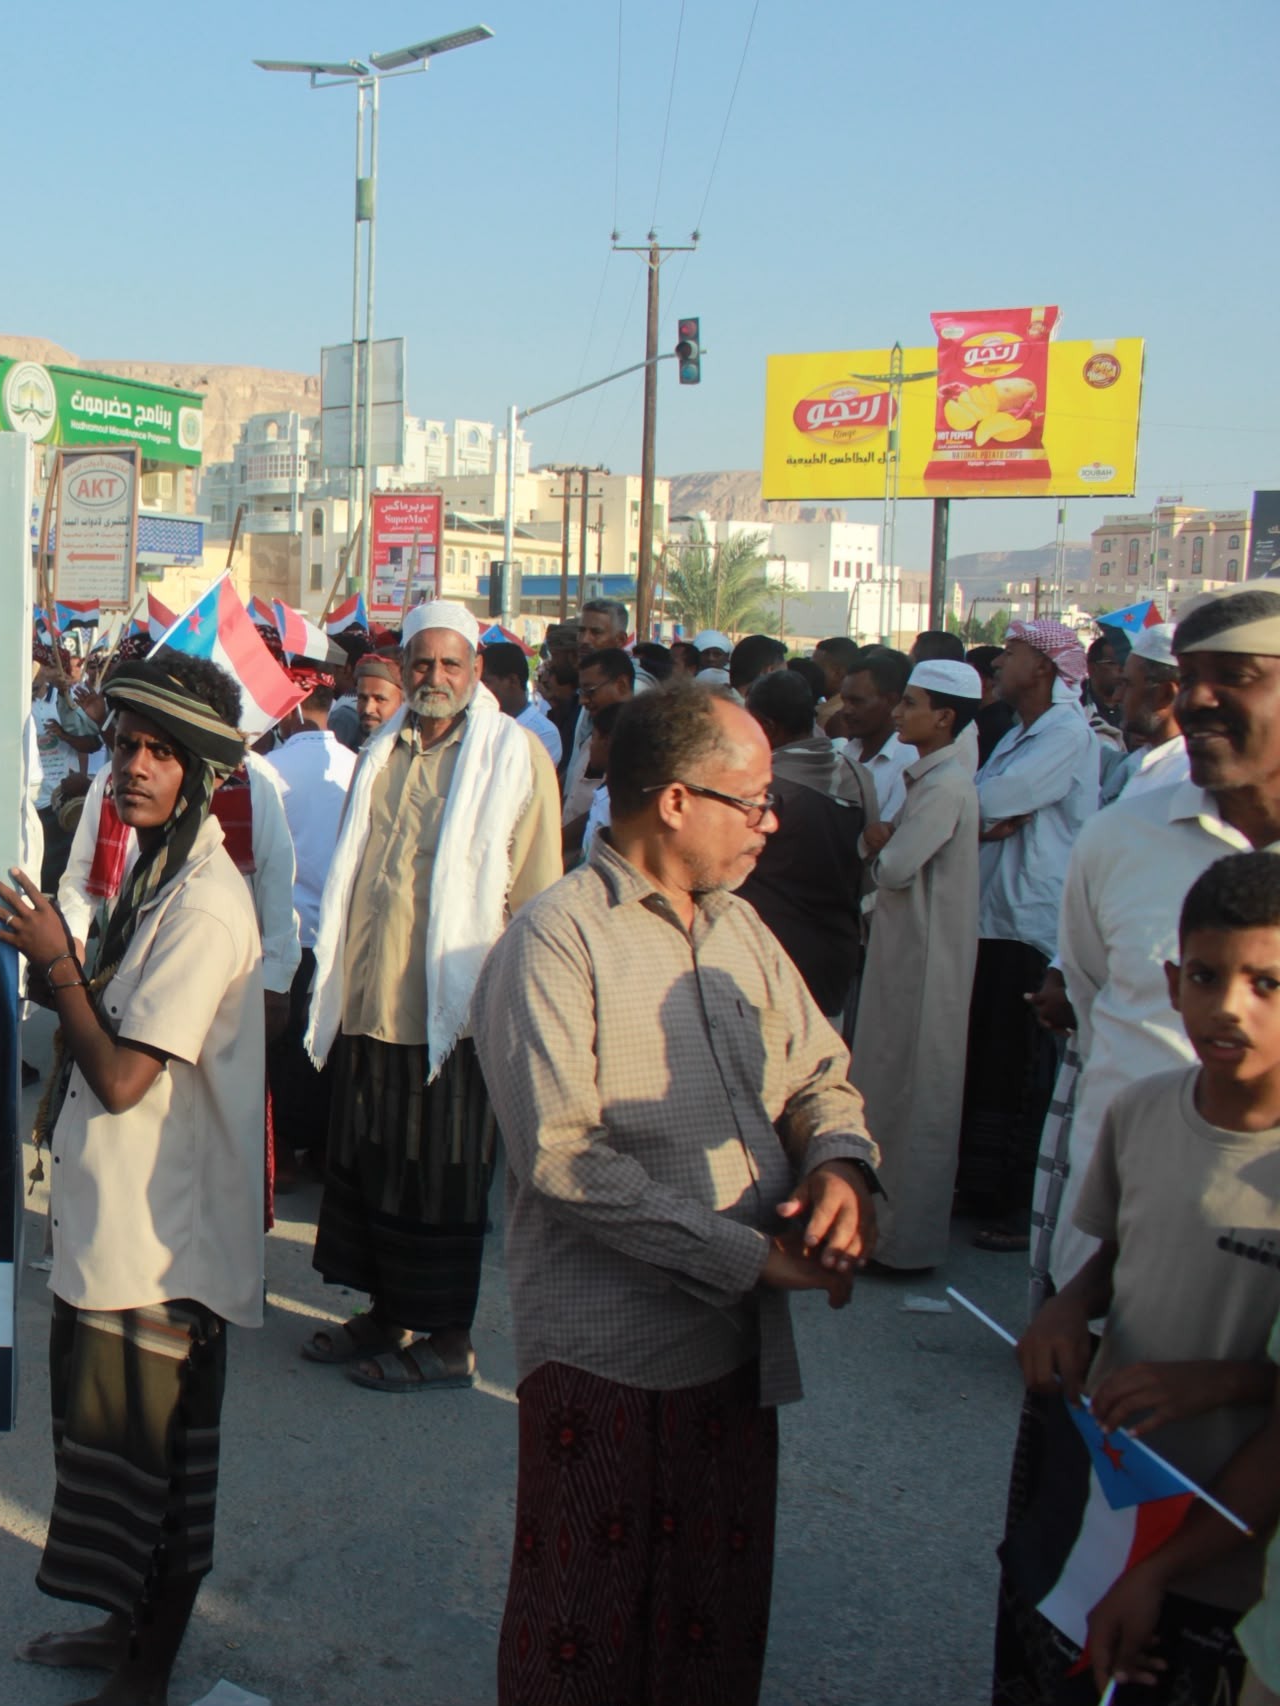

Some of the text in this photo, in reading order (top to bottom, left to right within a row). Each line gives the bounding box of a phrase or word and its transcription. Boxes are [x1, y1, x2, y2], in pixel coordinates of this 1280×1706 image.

[70, 389, 173, 431] برنامج حضرموت
[76, 478, 118, 498] AKT
